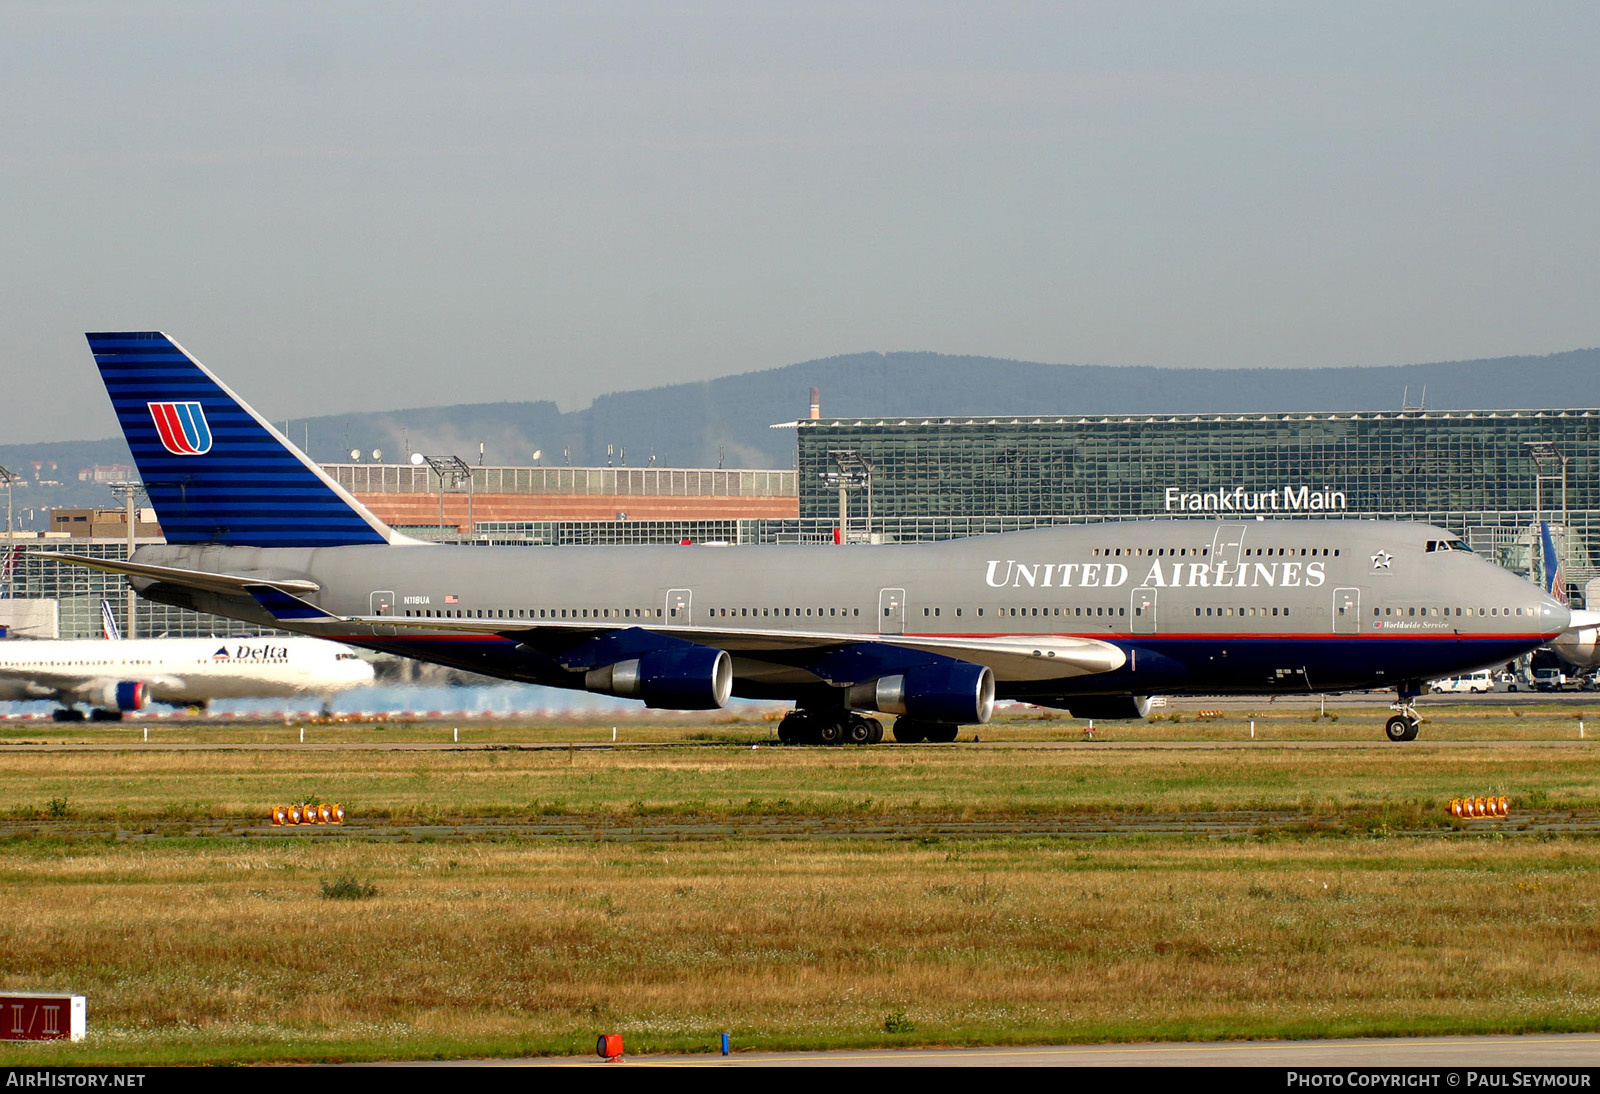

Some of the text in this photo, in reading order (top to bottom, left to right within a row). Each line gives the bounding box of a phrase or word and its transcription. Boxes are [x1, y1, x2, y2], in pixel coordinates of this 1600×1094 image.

[1165, 485, 1346, 511] Frankfurt Main
[985, 558, 1326, 588] UNITED AIRLINES
[403, 596, 431, 605] N118UA
[1383, 621, 1449, 630] Worldwide Service
[236, 644, 288, 659] Delta
